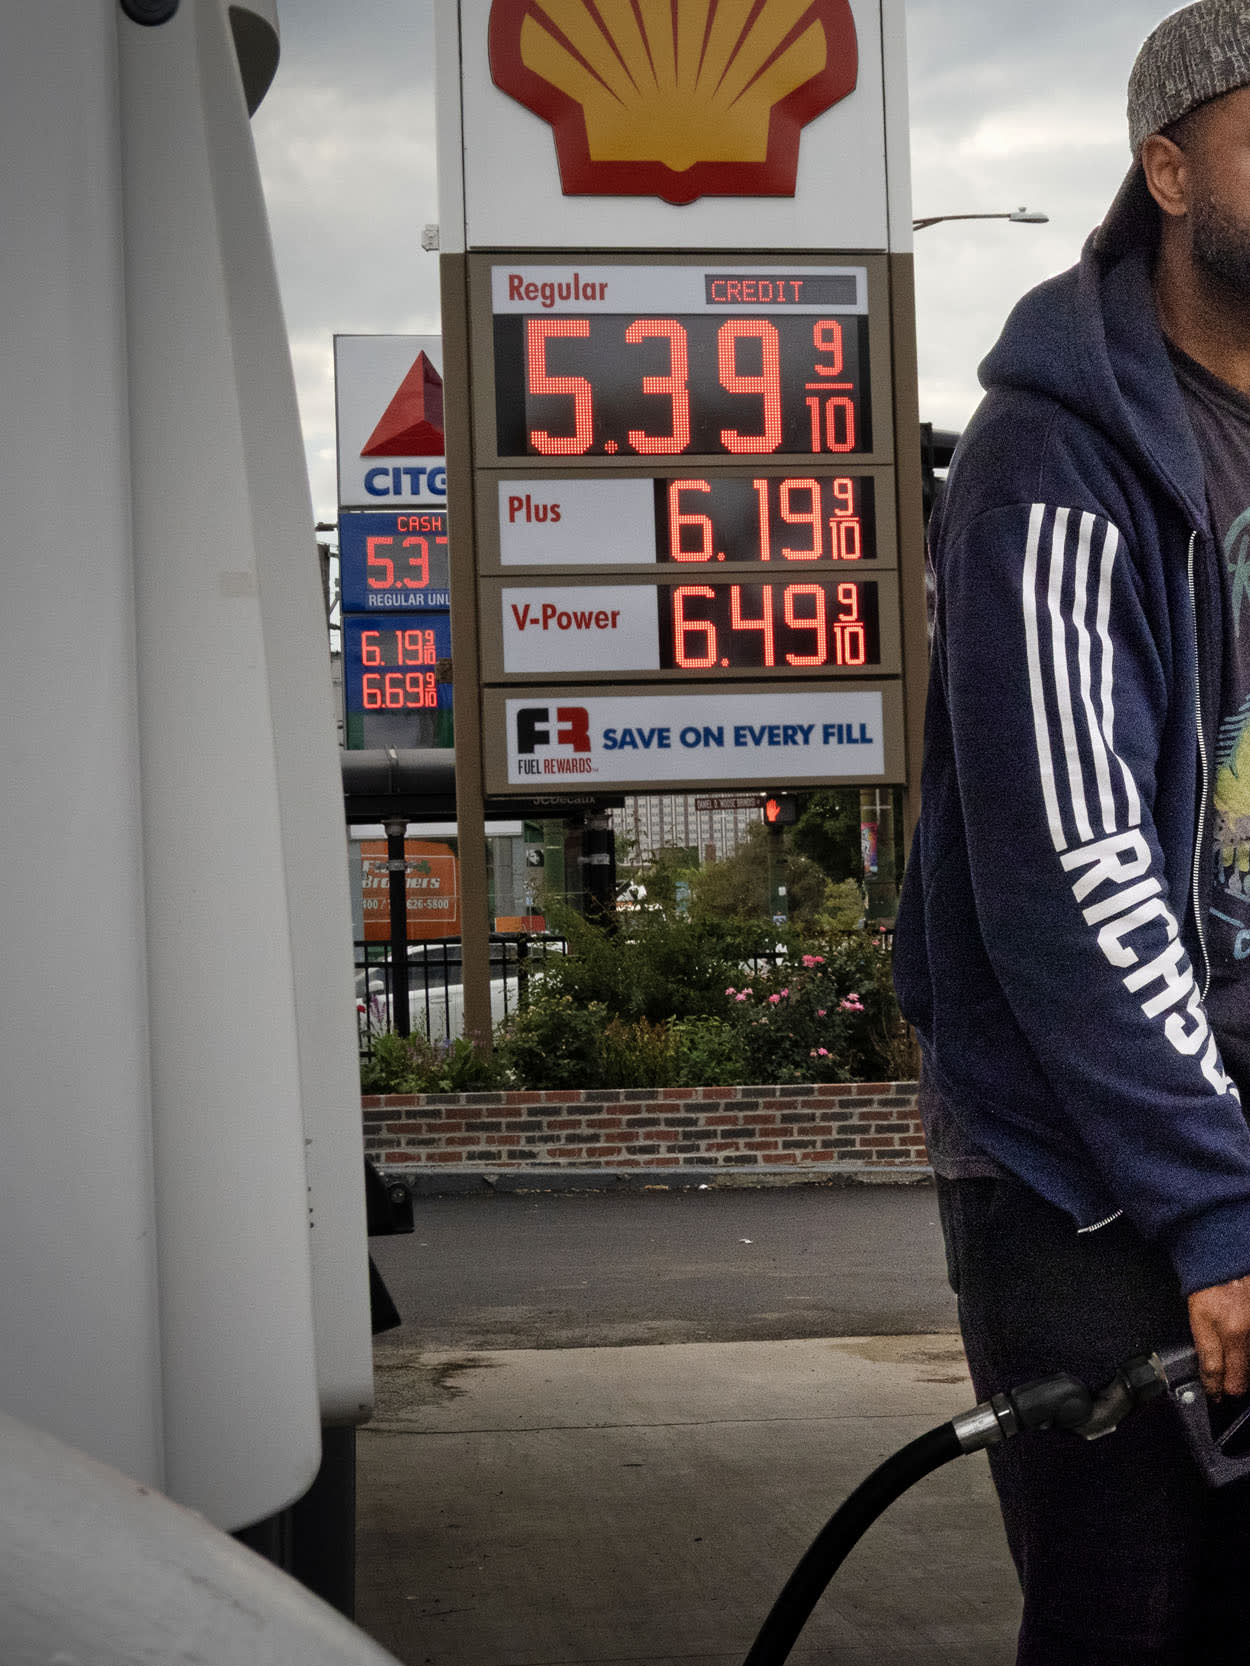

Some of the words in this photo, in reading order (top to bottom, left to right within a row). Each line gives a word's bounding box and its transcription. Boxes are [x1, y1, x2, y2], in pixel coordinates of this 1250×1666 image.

[509, 274, 608, 308] Regular
[712, 280, 804, 302] CREDIT
[528, 320, 783, 456] 5.39
[397, 516, 442, 533] CASH
[509, 496, 561, 523] Plus
[668, 479, 823, 563] 6.19
[369, 593, 425, 607] REGULAR
[511, 603, 621, 632] V-Power
[672, 584, 828, 668] 6.49
[361, 629, 424, 667] 6.19
[362, 672, 425, 709] 6.69
[603, 725, 672, 750] SAVE
[680, 724, 724, 749] ON
[733, 723, 815, 748] EVERY
[824, 722, 873, 746] FILL
[518, 759, 541, 775] FUEL
[544, 757, 592, 775] REWARDS
